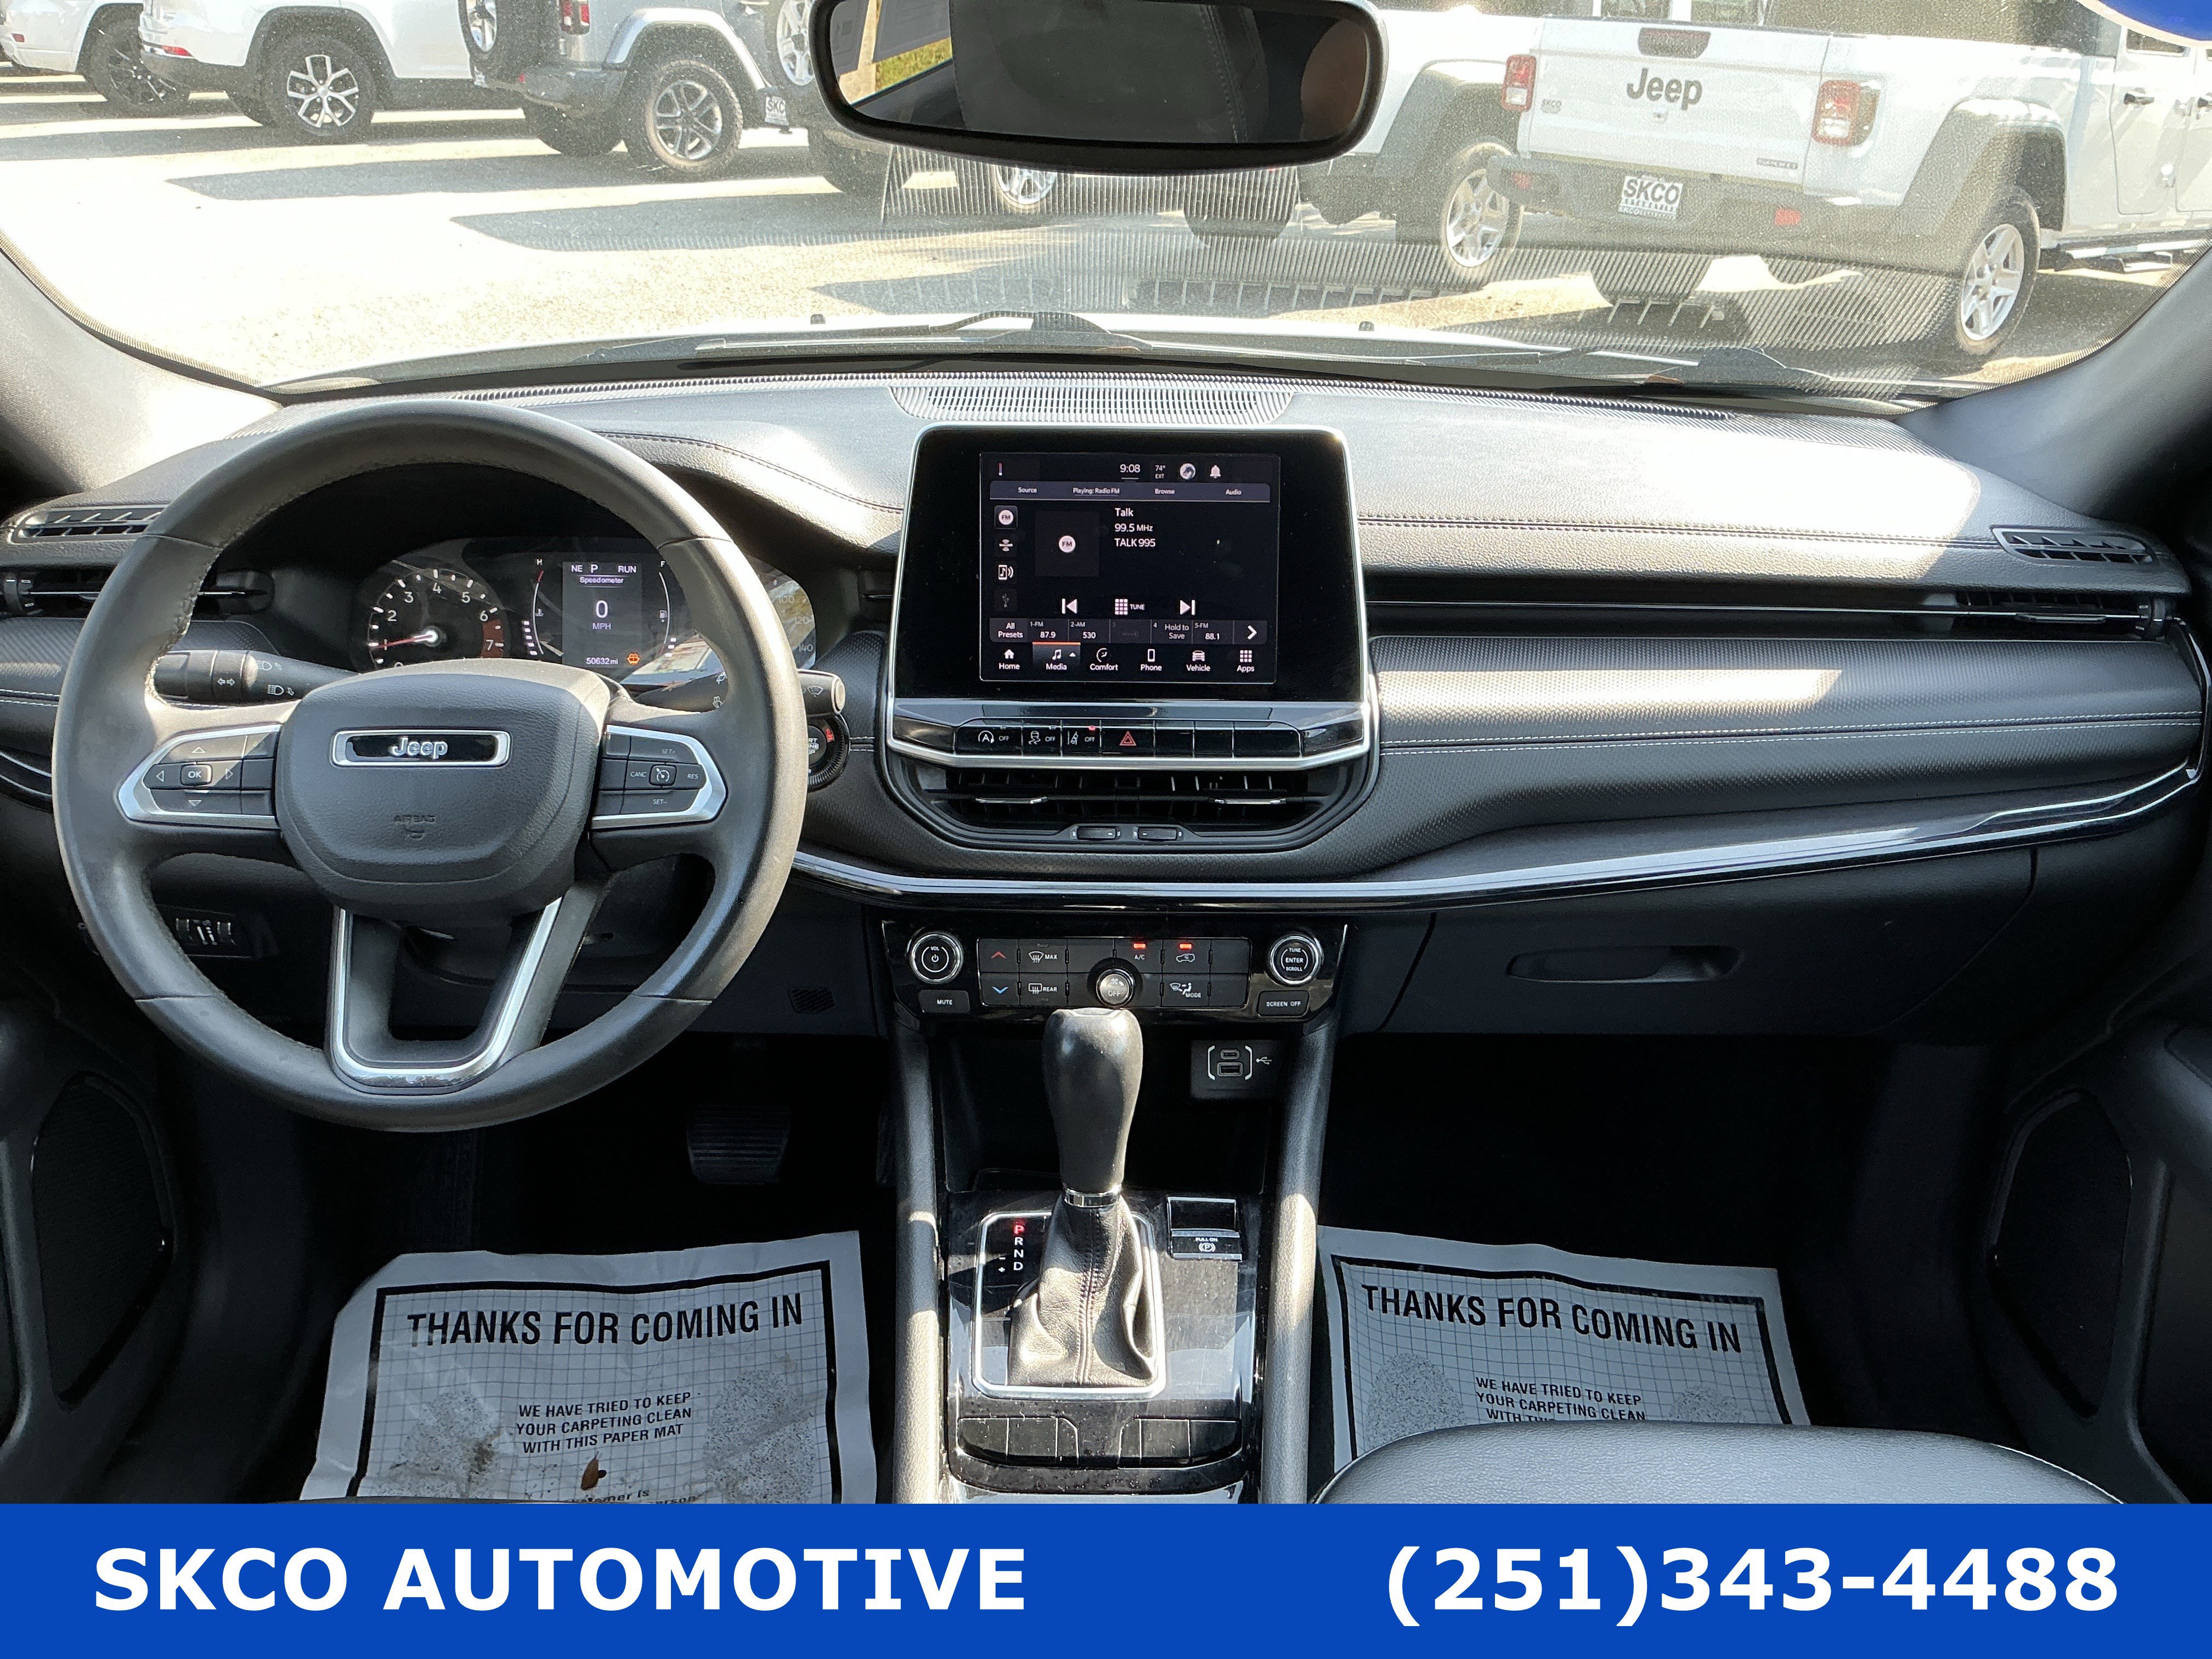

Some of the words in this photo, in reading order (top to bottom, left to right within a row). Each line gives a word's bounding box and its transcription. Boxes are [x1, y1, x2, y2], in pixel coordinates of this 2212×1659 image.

[1627, 68, 1702, 110] Jeep
[766, 98, 786, 114] SKC
[1624, 179, 1680, 205] SKCO
[1120, 464, 1141, 473] 9:08
[1114, 507, 1134, 517] Talk
[1114, 523, 1135, 532] 99.5
[1114, 537, 1137, 547] TALK
[1138, 538, 1156, 547] 995
[590, 564, 599, 573] P
[618, 565, 637, 573] RUN
[579, 577, 624, 585] Speedometer
[432, 583, 442, 594] 4
[404, 591, 414, 603] 3
[461, 591, 471, 603] 5
[596, 600, 610, 618] 0
[387, 610, 397, 622] 2
[479, 610, 489, 622] 6
[486, 639, 494, 651] 7
[798, 643, 814, 653] 140
[1237, 665, 1255, 673] Apps
[392, 735, 449, 760] Jeep
[188, 770, 202, 779] OK
[1013, 1224, 1025, 1235] P
[1014, 1237, 1024, 1246] R
[1014, 1249, 1024, 1259] N
[1013, 1261, 1024, 1272] D
[408, 1311, 540, 1347] THANKS
[554, 1311, 618, 1345] FOR
[631, 1301, 760, 1345] COMING
[772, 1294, 803, 1329] IN
[1362, 1284, 1486, 1326] THANKS
[1498, 1297, 1562, 1330] FOR
[1573, 1305, 1697, 1350] COMING
[1707, 1323, 1742, 1354] IN
[1476, 1376, 1497, 1390] WE
[1502, 1380, 1537, 1395] HAVE
[1540, 1383, 1582, 1398] TRIED
[1584, 1388, 1603, 1403] TO
[1607, 1392, 1641, 1406] KEEP
[518, 1403, 542, 1418] WE
[545, 1400, 583, 1417] HAVE
[587, 1398, 630, 1414] TRIED
[633, 1396, 652, 1410] TO
[657, 1391, 691, 1408] KEEP
[1476, 1392, 1515, 1408] YOUR
[1519, 1398, 1596, 1419] CARPETING
[1601, 1408, 1645, 1421] CLEAN
[516, 1420, 556, 1436] YOUR
[561, 1413, 642, 1434] CARPETING
[646, 1407, 692, 1424] CLEAN
[1486, 1408, 1522, 1423] WITH
[523, 1437, 562, 1454] WITH
[566, 1434, 599, 1451] THIS
[602, 1429, 648, 1446] PAPER
[654, 1424, 683, 1440] MAT
[637, 1489, 650, 1498] is
